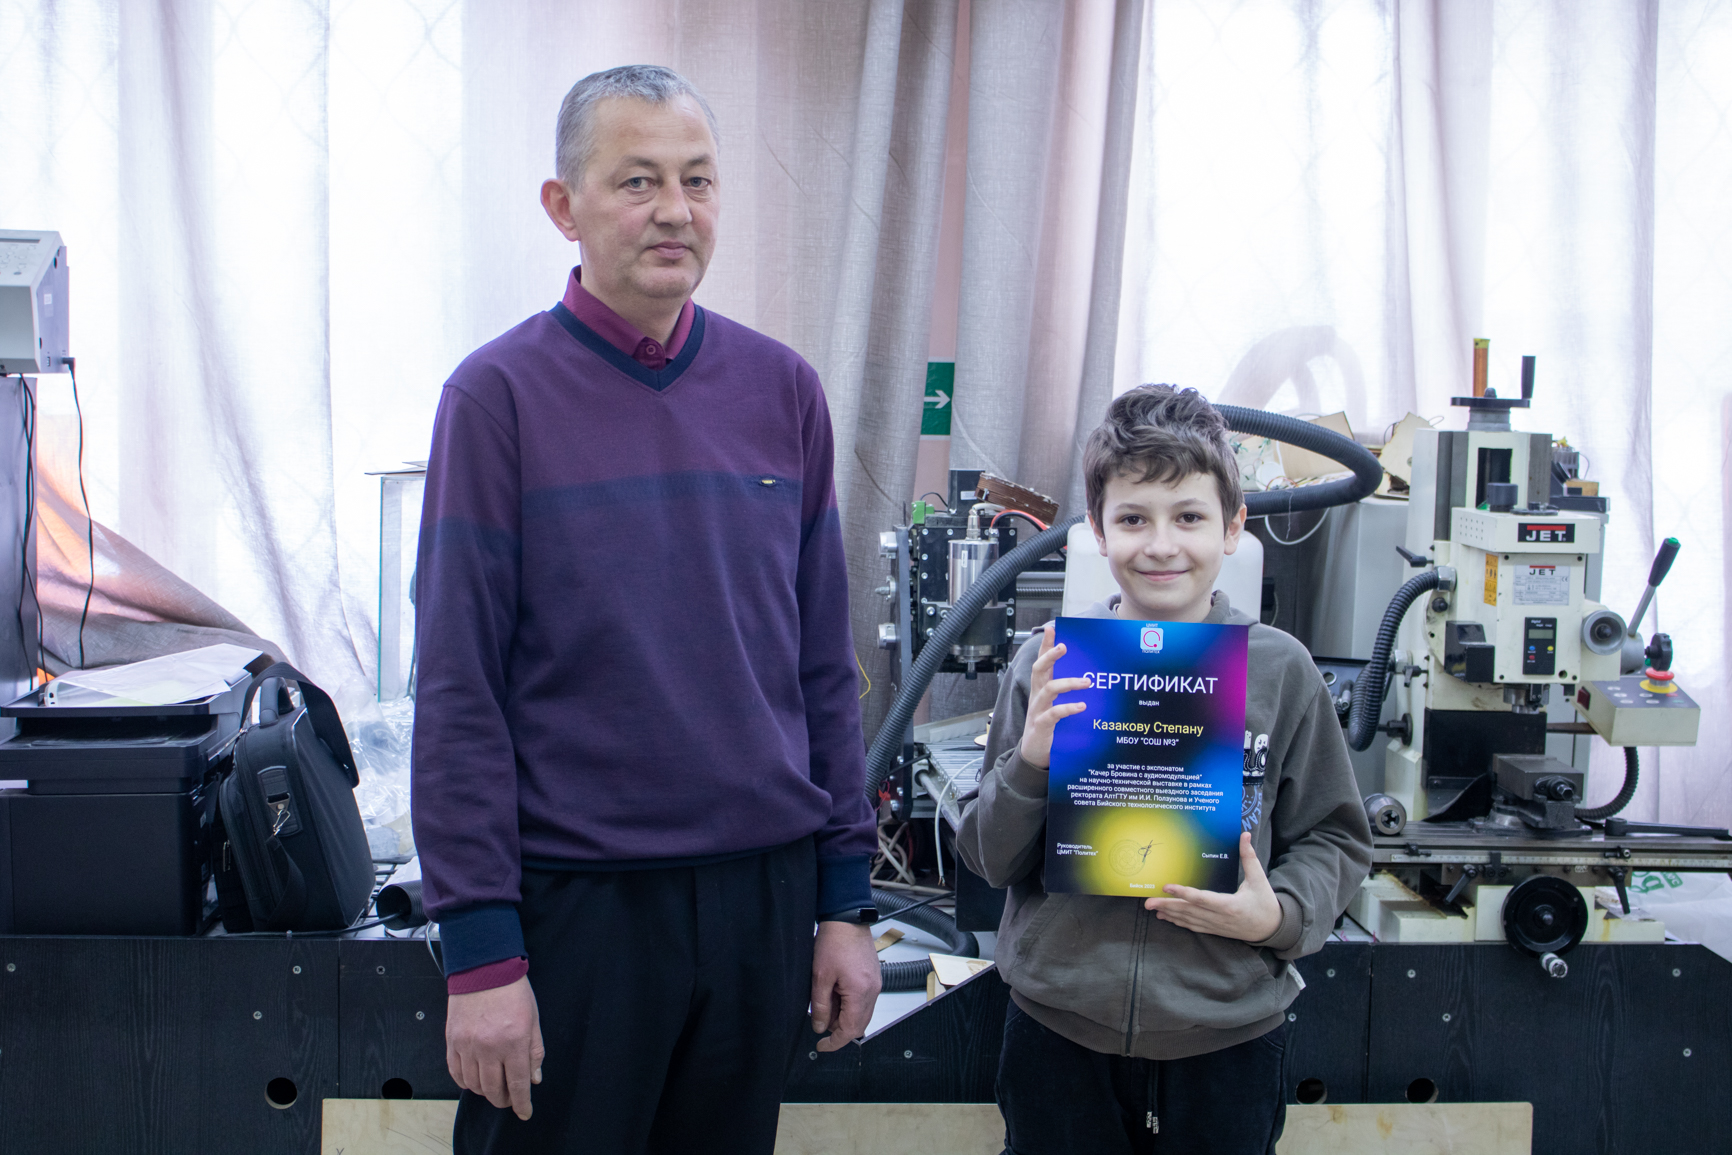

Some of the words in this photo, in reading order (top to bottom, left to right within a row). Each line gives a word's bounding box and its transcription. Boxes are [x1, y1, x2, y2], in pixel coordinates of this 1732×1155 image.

[1526, 530, 1566, 541] JET
[1083, 672, 1218, 694] СЕРТИФИКАТ
[1093, 719, 1150, 734] Казакову
[1154, 722, 1204, 737] Степану
[1163, 738, 1180, 746] №3"
[1088, 769, 1109, 777] "Качер
